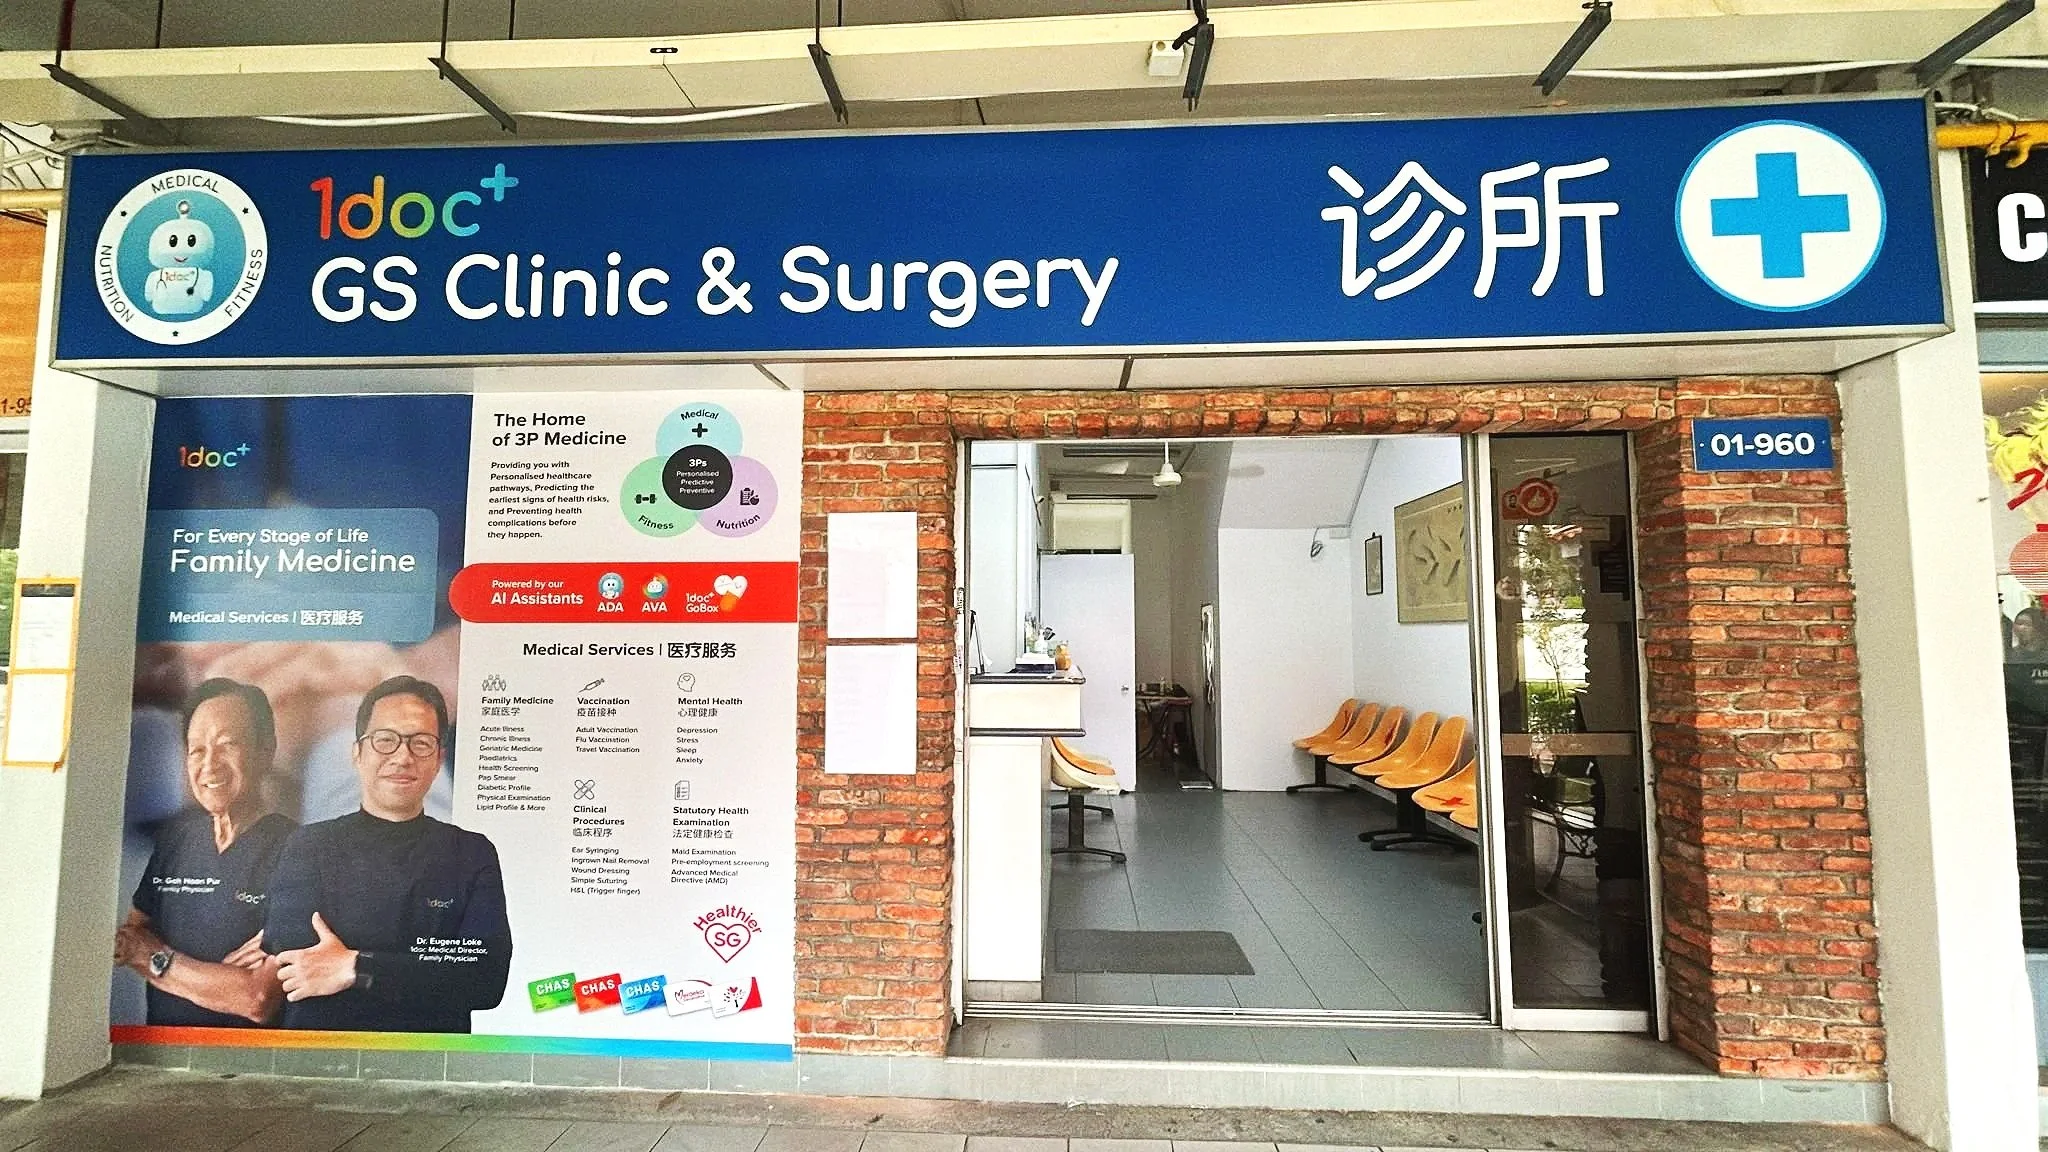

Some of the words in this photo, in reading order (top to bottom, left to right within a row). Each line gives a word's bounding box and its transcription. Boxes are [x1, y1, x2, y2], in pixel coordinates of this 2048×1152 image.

[151, 175, 219, 194] MEDICAL
[1320, 156, 1620, 301] 诊所
[100, 244, 135, 323] NUTRITION
[224, 248, 263, 318] FITNESS
[311, 256, 418, 323] GS
[445, 251, 670, 320] Clinic
[696, 246, 754, 316] &
[779, 244, 1119, 328] Surgery
[680, 408, 720, 421] Medical
[494, 413, 527, 427] The
[532, 413, 586, 426] Home
[492, 433, 511, 446] of
[515, 432, 539, 446] 3P
[544, 431, 627, 446] Medicine
[1710, 432, 1816, 457] 01-960
[491, 461, 531, 470] Providing
[688, 458, 707, 467] 3Ps
[546, 472, 592, 480] healthcare
[489, 485, 533, 493] pathways,
[534, 484, 578, 492] Predicting
[506, 508, 553, 516] Preventing
[555, 507, 582, 515] health
[488, 519, 547, 527] complications
[638, 514, 674, 530] Fitness
[715, 514, 761, 530] Nutrition
[173, 529, 203, 544] For
[208, 529, 255, 546] Every
[260, 529, 310, 546] Stage
[315, 528, 333, 543] of
[337, 528, 369, 543] Life
[487, 531, 506, 539] they
[508, 531, 543, 539] happen.
[170, 549, 269, 579] Family
[278, 548, 415, 573] Medicine
[492, 579, 532, 588] Powered
[534, 579, 546, 590] by
[491, 592, 507, 604] AI
[511, 592, 584, 605] Assistants
[597, 602, 624, 613] ADA
[641, 602, 668, 612] AVA
[686, 603, 719, 613] GoBox
[169, 611, 225, 624] Medical
[228, 611, 289, 624] Services
[300, 610, 364, 626] 医疗服务
[523, 643, 583, 657] Medical
[588, 643, 654, 657] Services
[667, 641, 737, 659] 医疗服务
[481, 697, 511, 705] Family
[577, 697, 630, 705] Vaccination
[678, 697, 710, 705] Mental
[712, 697, 743, 705] Health
[678, 707, 718, 718] 心理健康
[676, 746, 697, 754] Sleep
[503, 765, 538, 773] Screening
[573, 805, 607, 813] Clinical
[673, 806, 716, 816] Statutory
[718, 807, 749, 815] Health
[573, 817, 625, 825] Procedures
[673, 818, 730, 826] Examination
[572, 827, 613, 838] 临床程序
[672, 829, 734, 839] 法定健康检查
[585, 847, 619, 855] Syringing
[671, 859, 731, 867] Pre-employment
[705, 877, 728, 885] (AMD)
[587, 887, 615, 895] (Trigger
[617, 887, 641, 895] finger)
[693, 904, 762, 935] Healthier
[416, 937, 428, 945] Dr.
[430, 937, 460, 946] Eugene
[462, 938, 482, 946] Loke
[714, 931, 742, 948] SG
[457, 946, 488, 954] Director,
[419, 954, 443, 963] Family
[443, 955, 478, 963] Physician
[536, 978, 570, 995] CHAS
[581, 979, 616, 996] CHAS
[626, 980, 660, 997] CHAS
